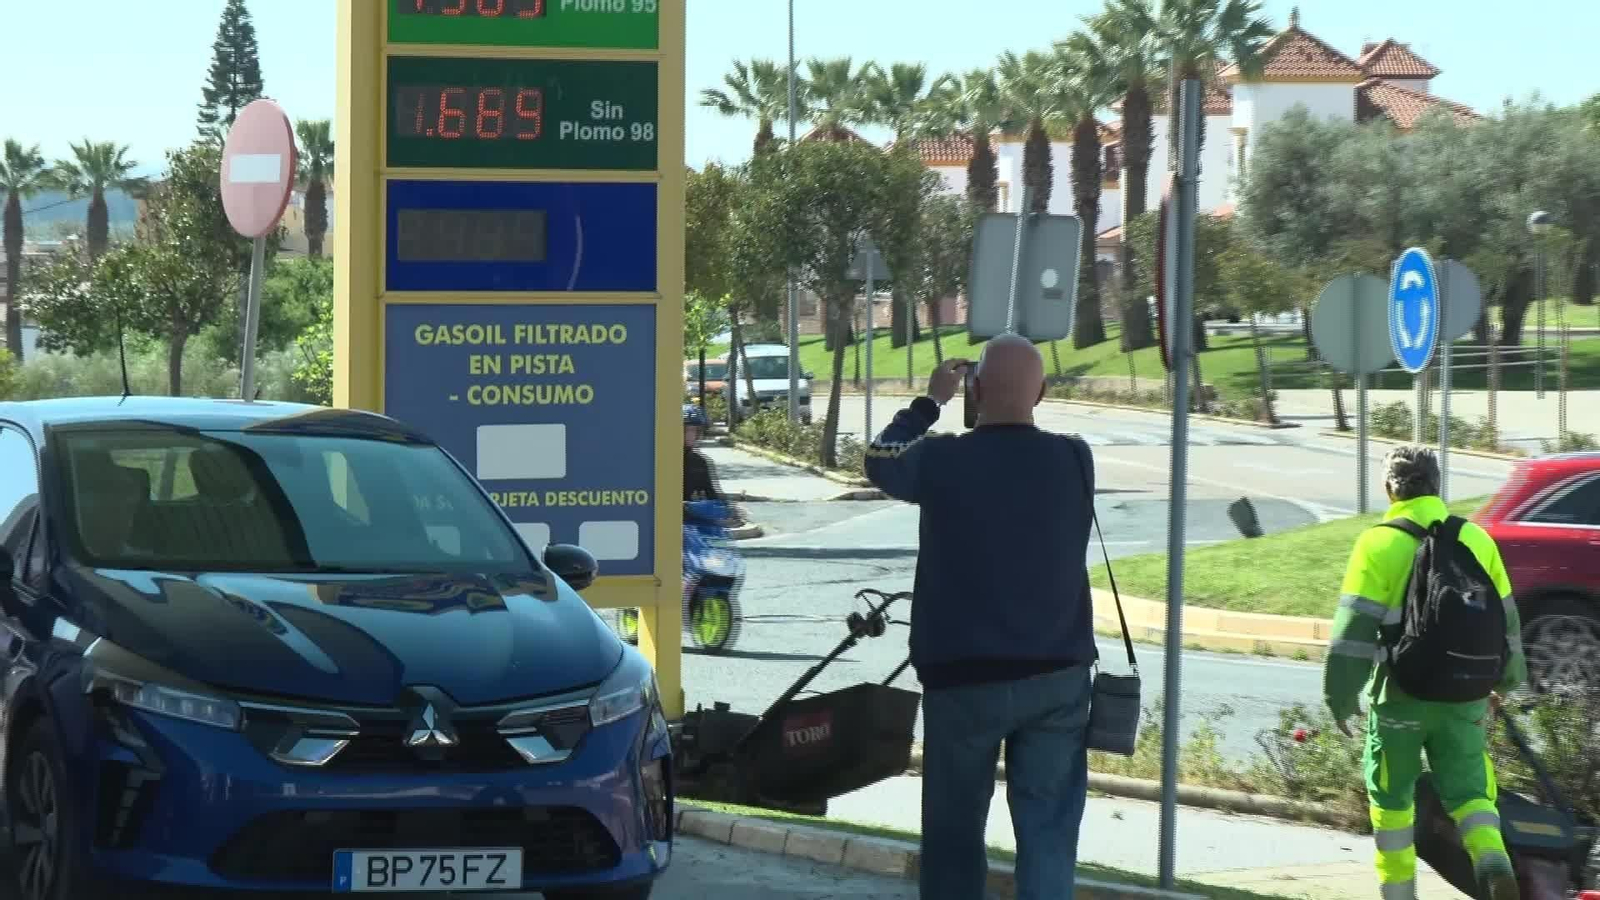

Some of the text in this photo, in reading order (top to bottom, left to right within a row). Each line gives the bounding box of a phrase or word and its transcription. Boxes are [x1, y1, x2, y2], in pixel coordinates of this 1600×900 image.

[560, 0, 626, 13] Plomo
[414, 87, 542, 139] 1.689
[590, 100, 624, 119] Sin
[559, 121, 654, 141] Plomo 98
[415, 324, 628, 345] GASOIL FILTRADO
[469, 354, 575, 375] EN PISTA
[467, 384, 594, 405] CONSUMO
[545, 489, 649, 507] DESCUENTO
[786, 724, 831, 747] TORO
